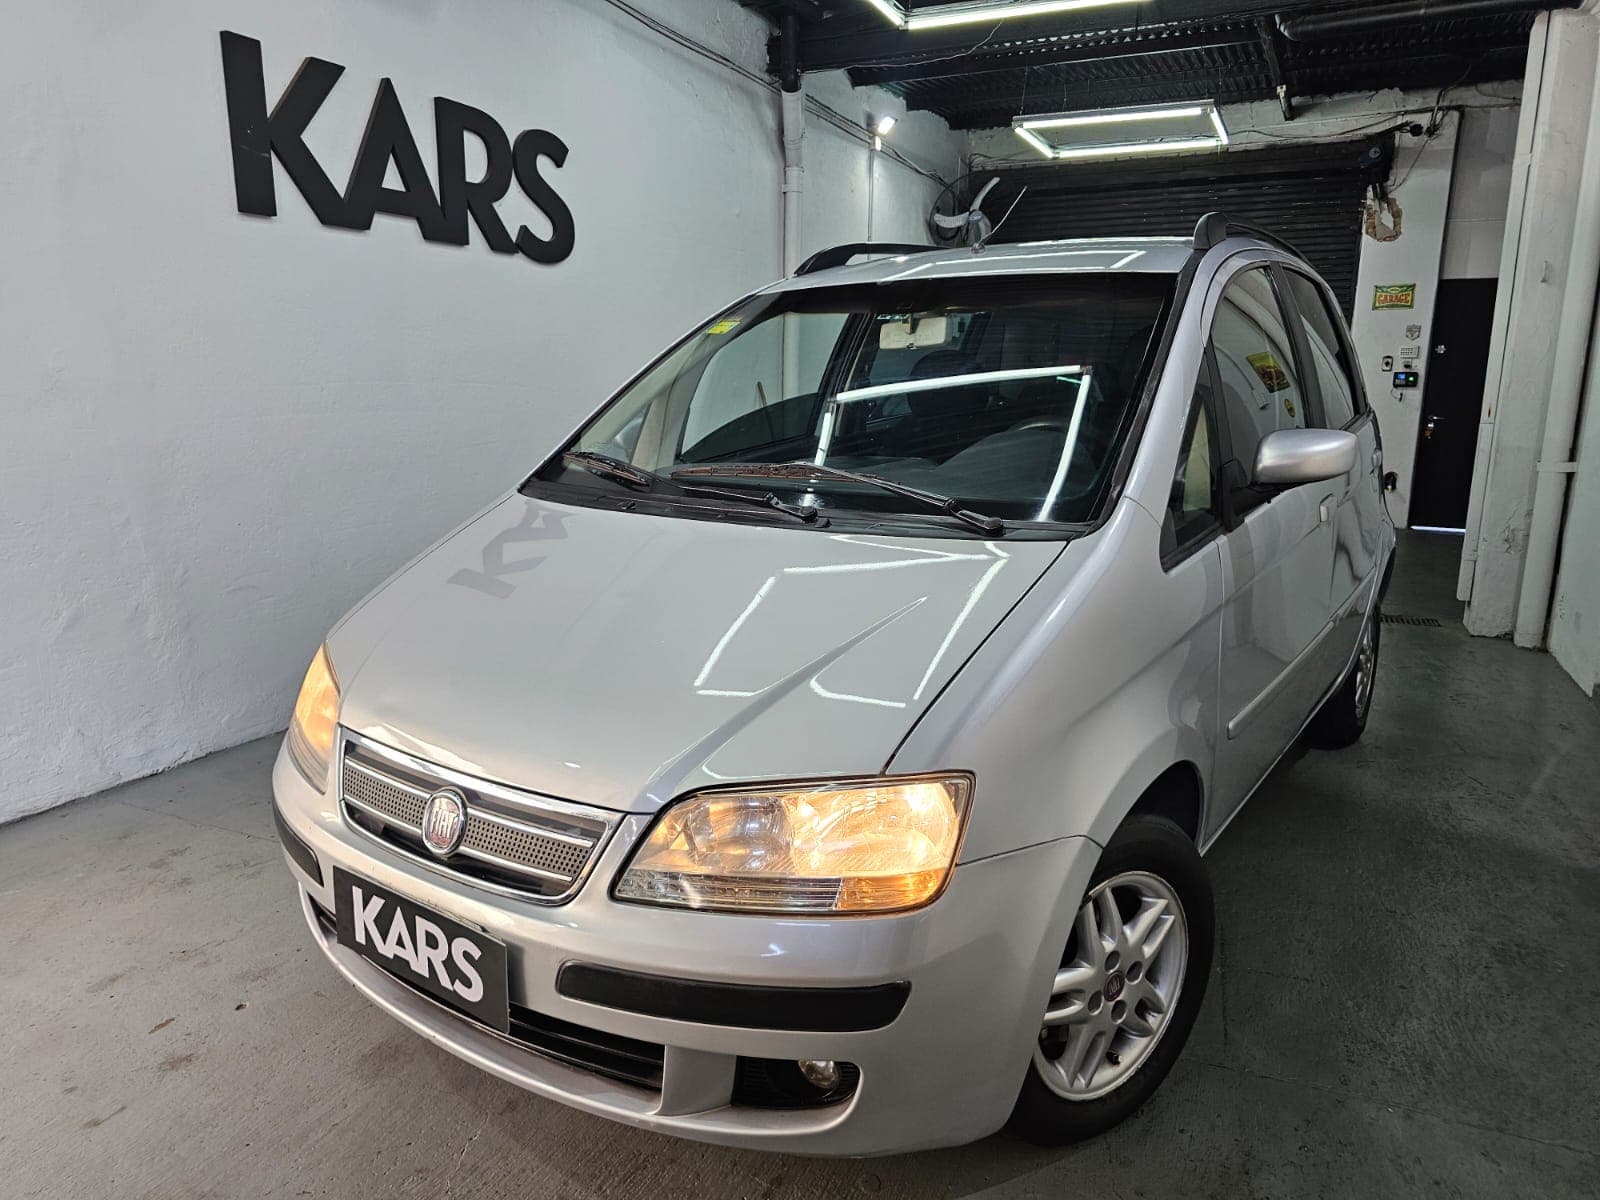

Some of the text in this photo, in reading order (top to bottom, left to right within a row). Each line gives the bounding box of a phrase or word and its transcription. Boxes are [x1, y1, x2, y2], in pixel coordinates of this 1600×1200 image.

[220, 30, 575, 265] KARS
[430, 807, 460, 840] FIAT
[352, 885, 484, 1003] KARS
